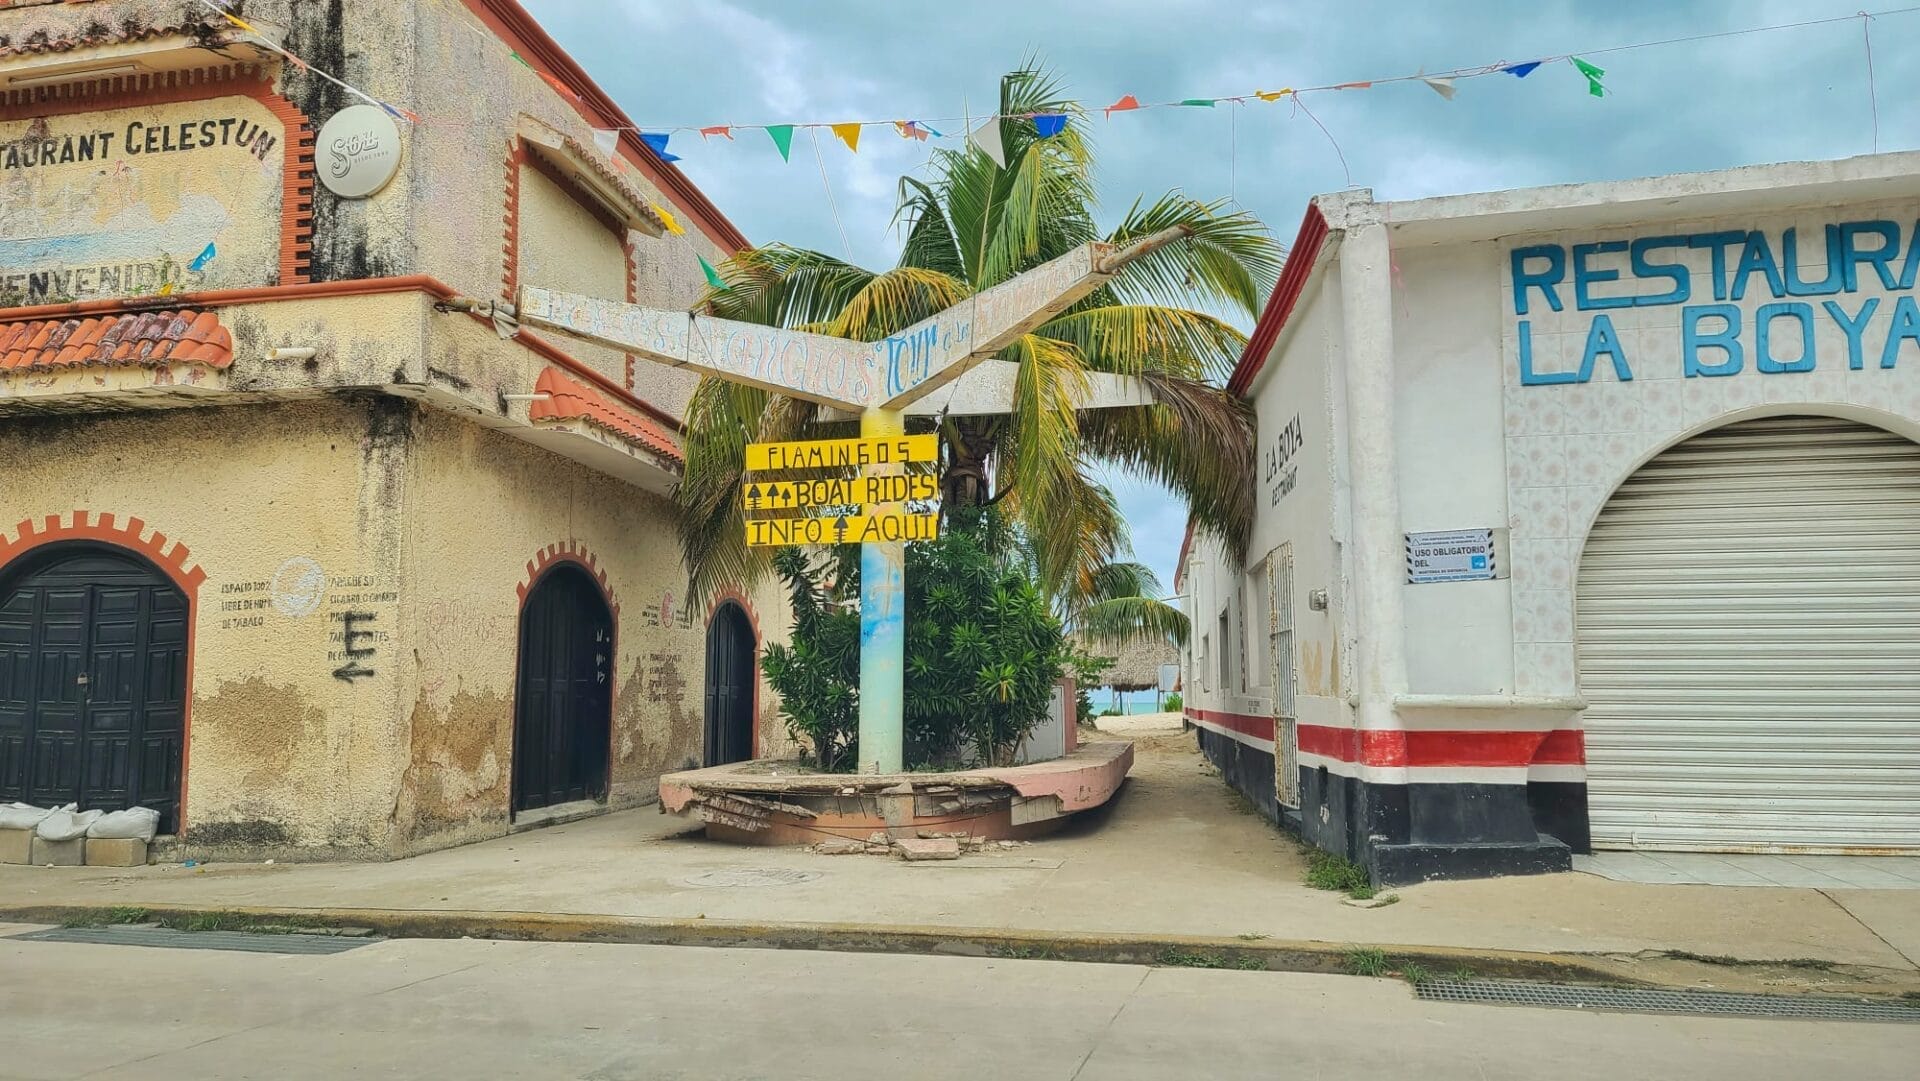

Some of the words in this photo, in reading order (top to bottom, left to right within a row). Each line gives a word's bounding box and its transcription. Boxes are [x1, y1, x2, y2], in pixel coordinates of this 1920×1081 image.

[125, 118, 276, 161] CELESTUN
[1518, 314, 1634, 386] LA
[1682, 296, 1920, 378] BOYA
[768, 442, 910, 470] FLAMINGOS
[1266, 445, 1278, 484] LA
[1279, 411, 1303, 469] BOYA
[792, 478, 856, 506] BOAT
[867, 474, 936, 504] RIDES
[751, 518, 823, 545] INFO
[860, 514, 933, 542] AQUI
[1414, 549, 1431, 558] USO
[1433, 545, 1486, 557] OBLIGATORIO
[1414, 560, 1430, 568] DEL
